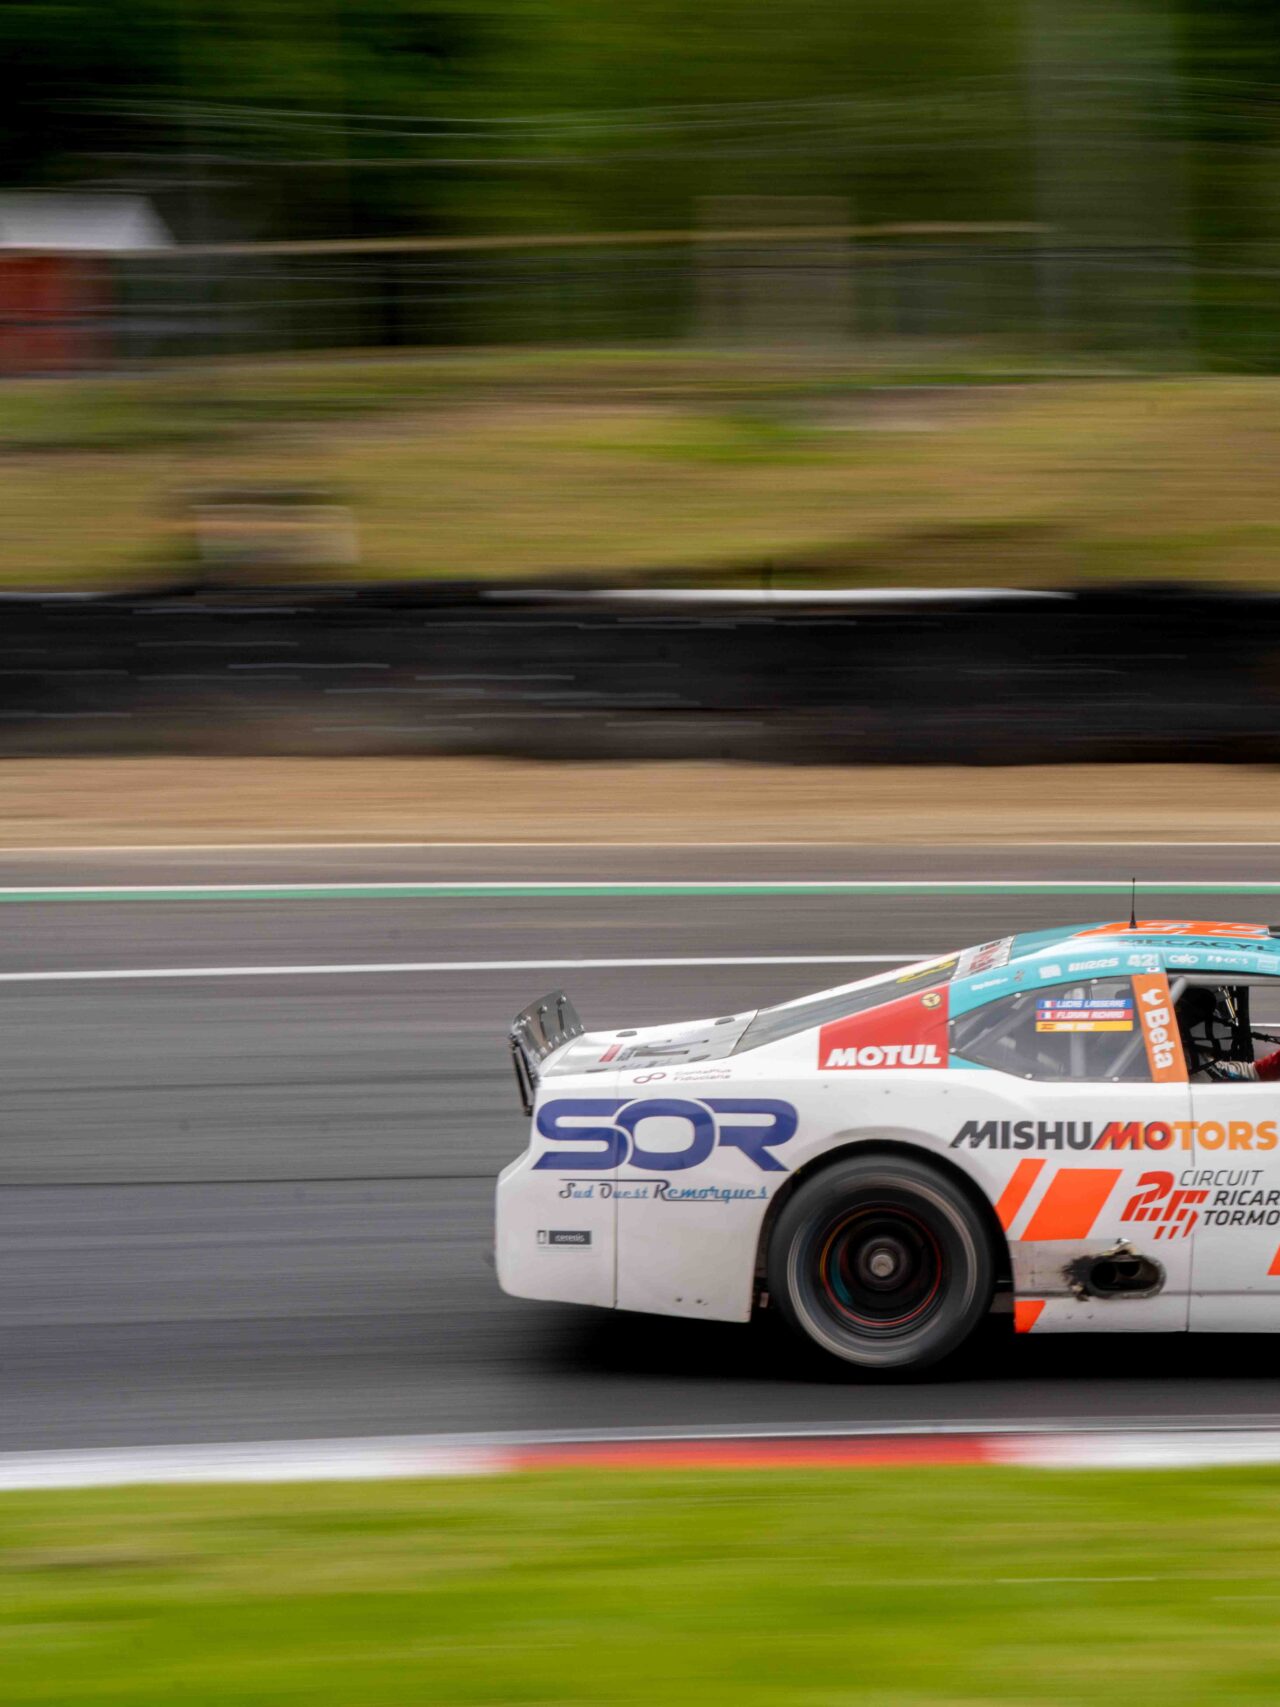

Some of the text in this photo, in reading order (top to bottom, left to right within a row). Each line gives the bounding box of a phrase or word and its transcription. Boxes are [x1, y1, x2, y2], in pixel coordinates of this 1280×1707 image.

[1144, 1008, 1173, 1069] Beta
[825, 1044, 942, 1067] MOTUL
[531, 1098, 799, 1172] SOR
[951, 1120, 1279, 1151] MISHUMOTORS
[1179, 1169, 1264, 1187] CIRCUIT
[558, 1182, 594, 1200] Sud
[1204, 1210, 1280, 1227] TORMO
